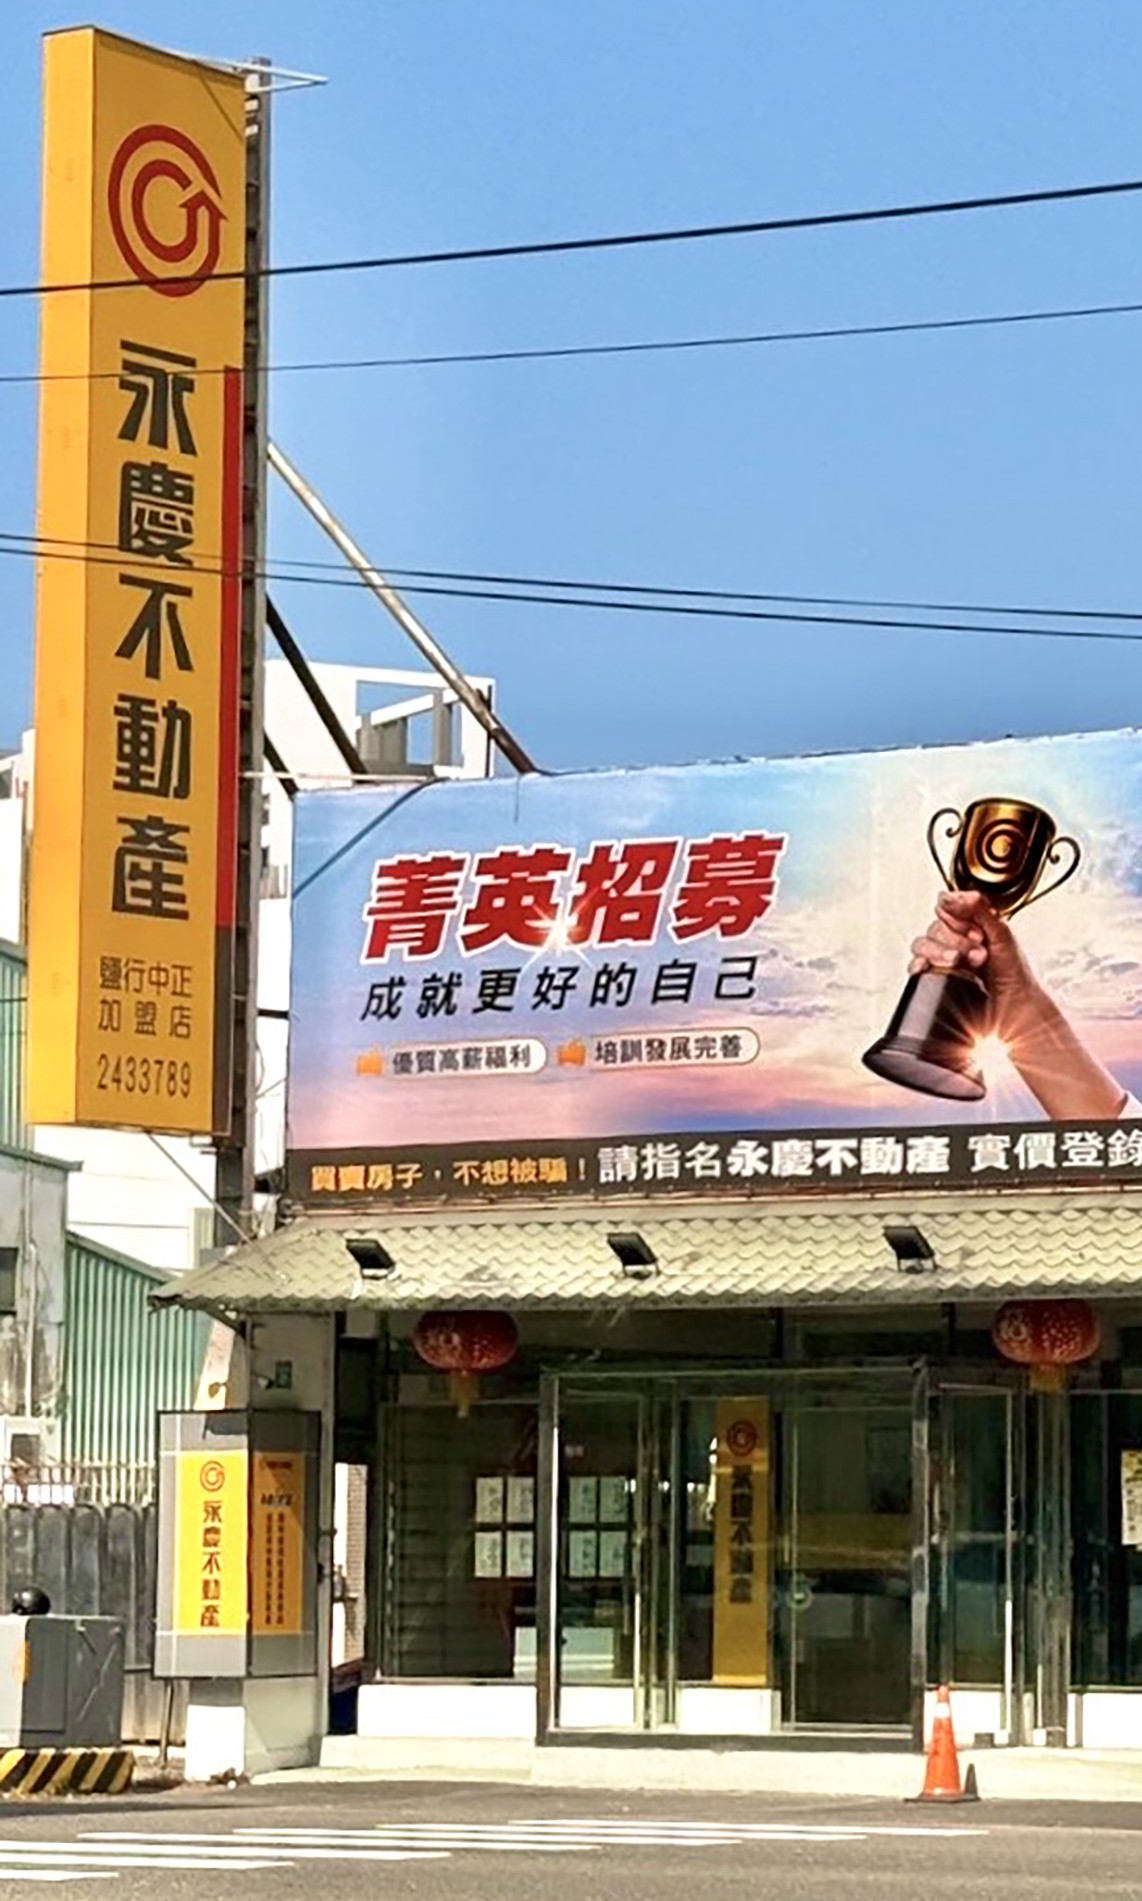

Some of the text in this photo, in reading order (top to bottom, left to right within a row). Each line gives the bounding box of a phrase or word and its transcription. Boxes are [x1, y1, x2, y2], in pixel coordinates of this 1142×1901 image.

[113, 340, 197, 921] 永慶不動產
[362, 832, 787, 962] 菁英招募
[99, 955, 193, 1000] 鹽行中正
[360, 957, 759, 1021] 成就更好的自己
[98, 998, 192, 1039] 加盟店
[392, 1043, 532, 1076] 優質高薪福利
[595, 1034, 743, 1064] 培訓發展完善
[97, 1053, 191, 1098] 2433789
